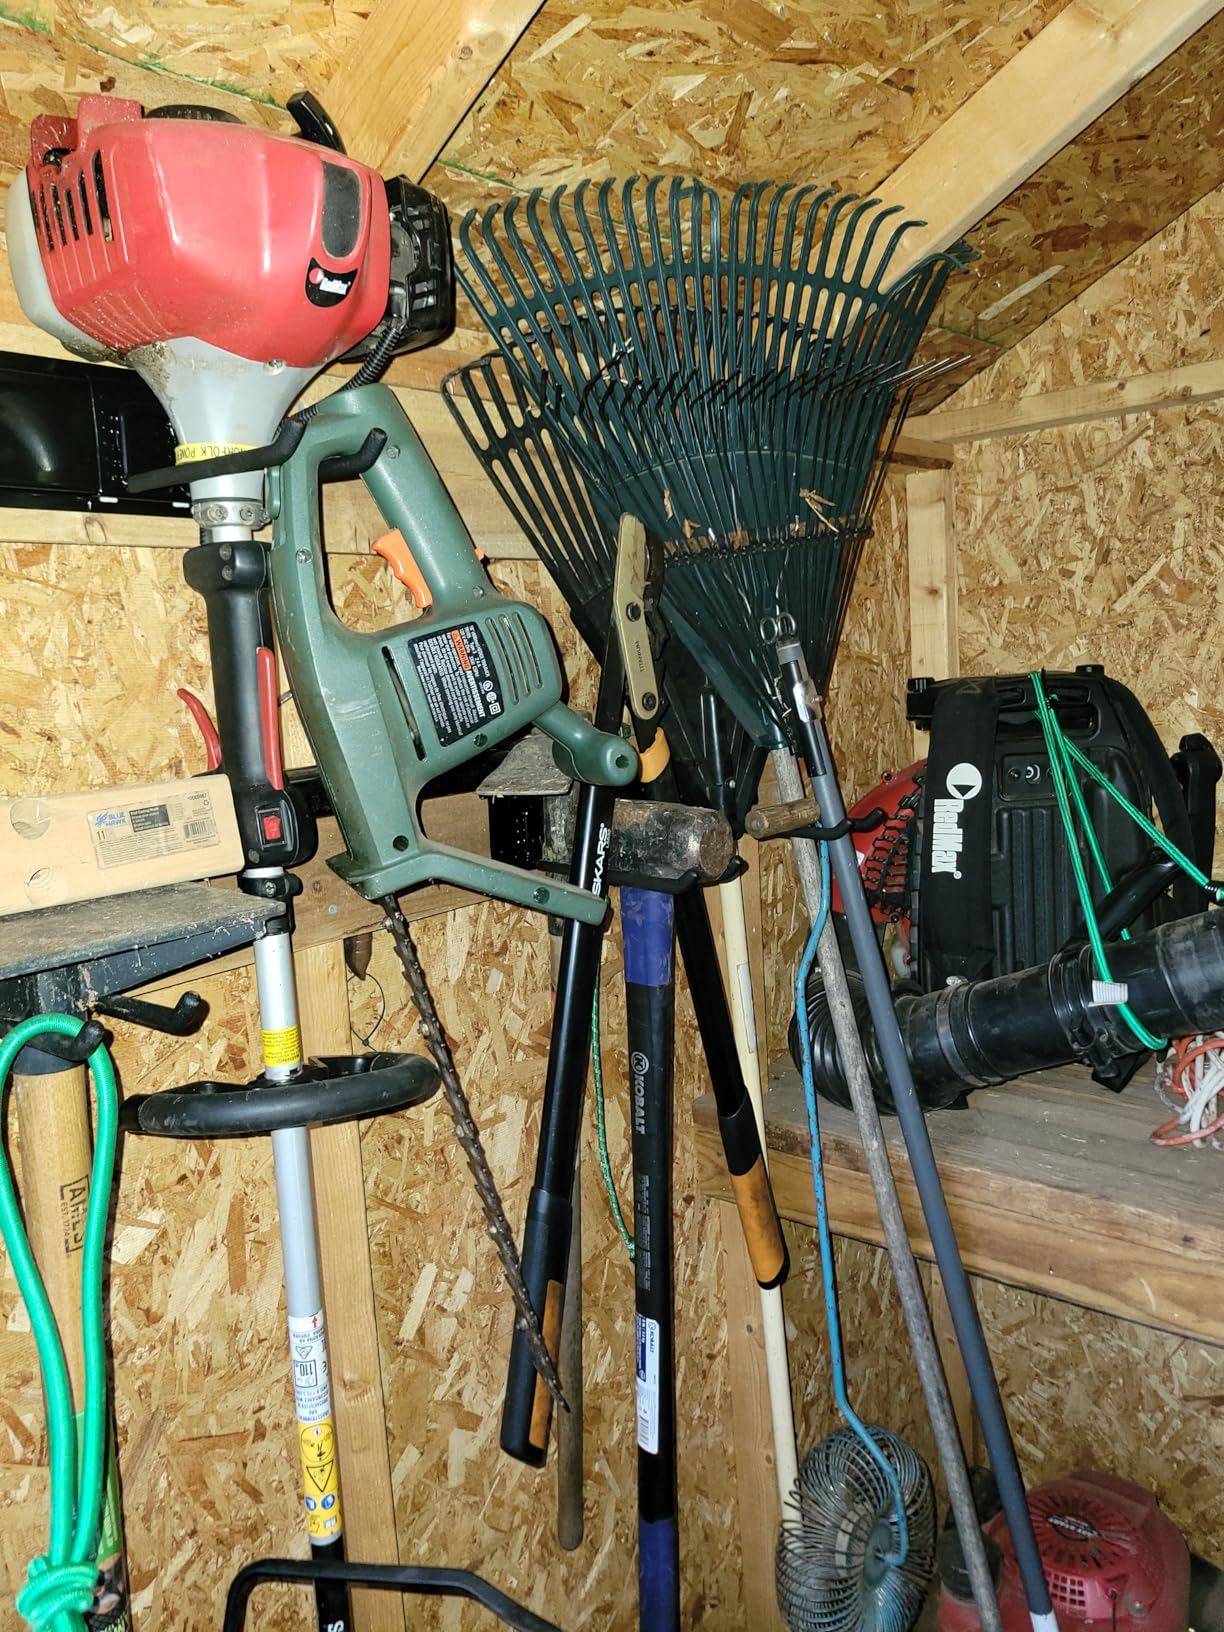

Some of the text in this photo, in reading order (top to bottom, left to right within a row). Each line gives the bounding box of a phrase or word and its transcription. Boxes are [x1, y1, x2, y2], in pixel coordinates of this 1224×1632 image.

[456, 639, 486, 718] WARNING AVERTISSEMENT
[107, 811, 125, 820] BLUE
[931, 798, 965, 874] RedMax
[593, 826, 607, 895] SKARS
[634, 1074, 646, 1135] KOBALT
[299, 1363, 313, 1376] 110
